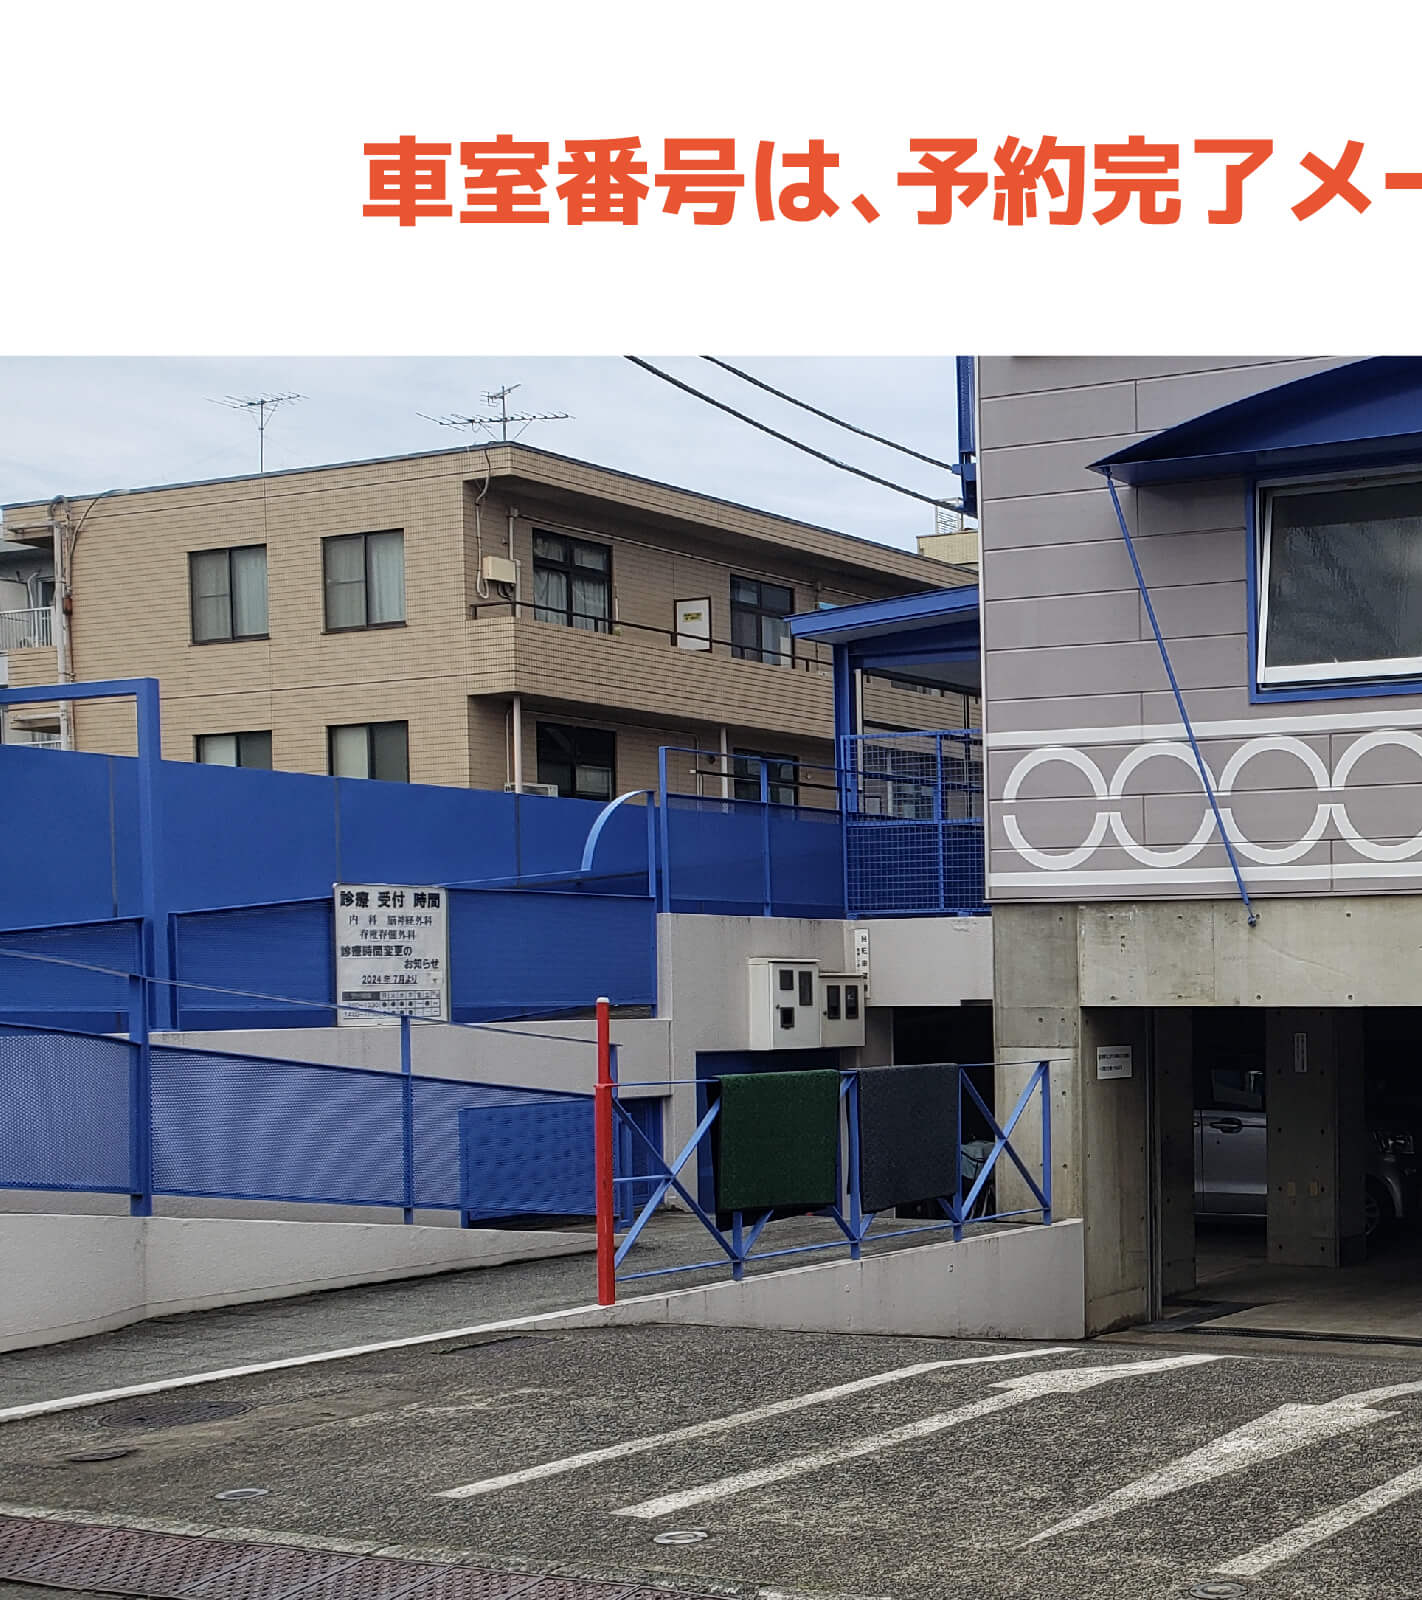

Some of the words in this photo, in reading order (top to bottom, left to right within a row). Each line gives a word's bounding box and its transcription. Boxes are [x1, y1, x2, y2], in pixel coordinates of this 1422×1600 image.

[340, 890, 369, 908] 診療
[377, 891, 405, 909] 受付
[413, 892, 440, 909] 時間
[340, 945, 413, 957] 診療時間変更の
[404, 958, 440, 970] お知らせ
